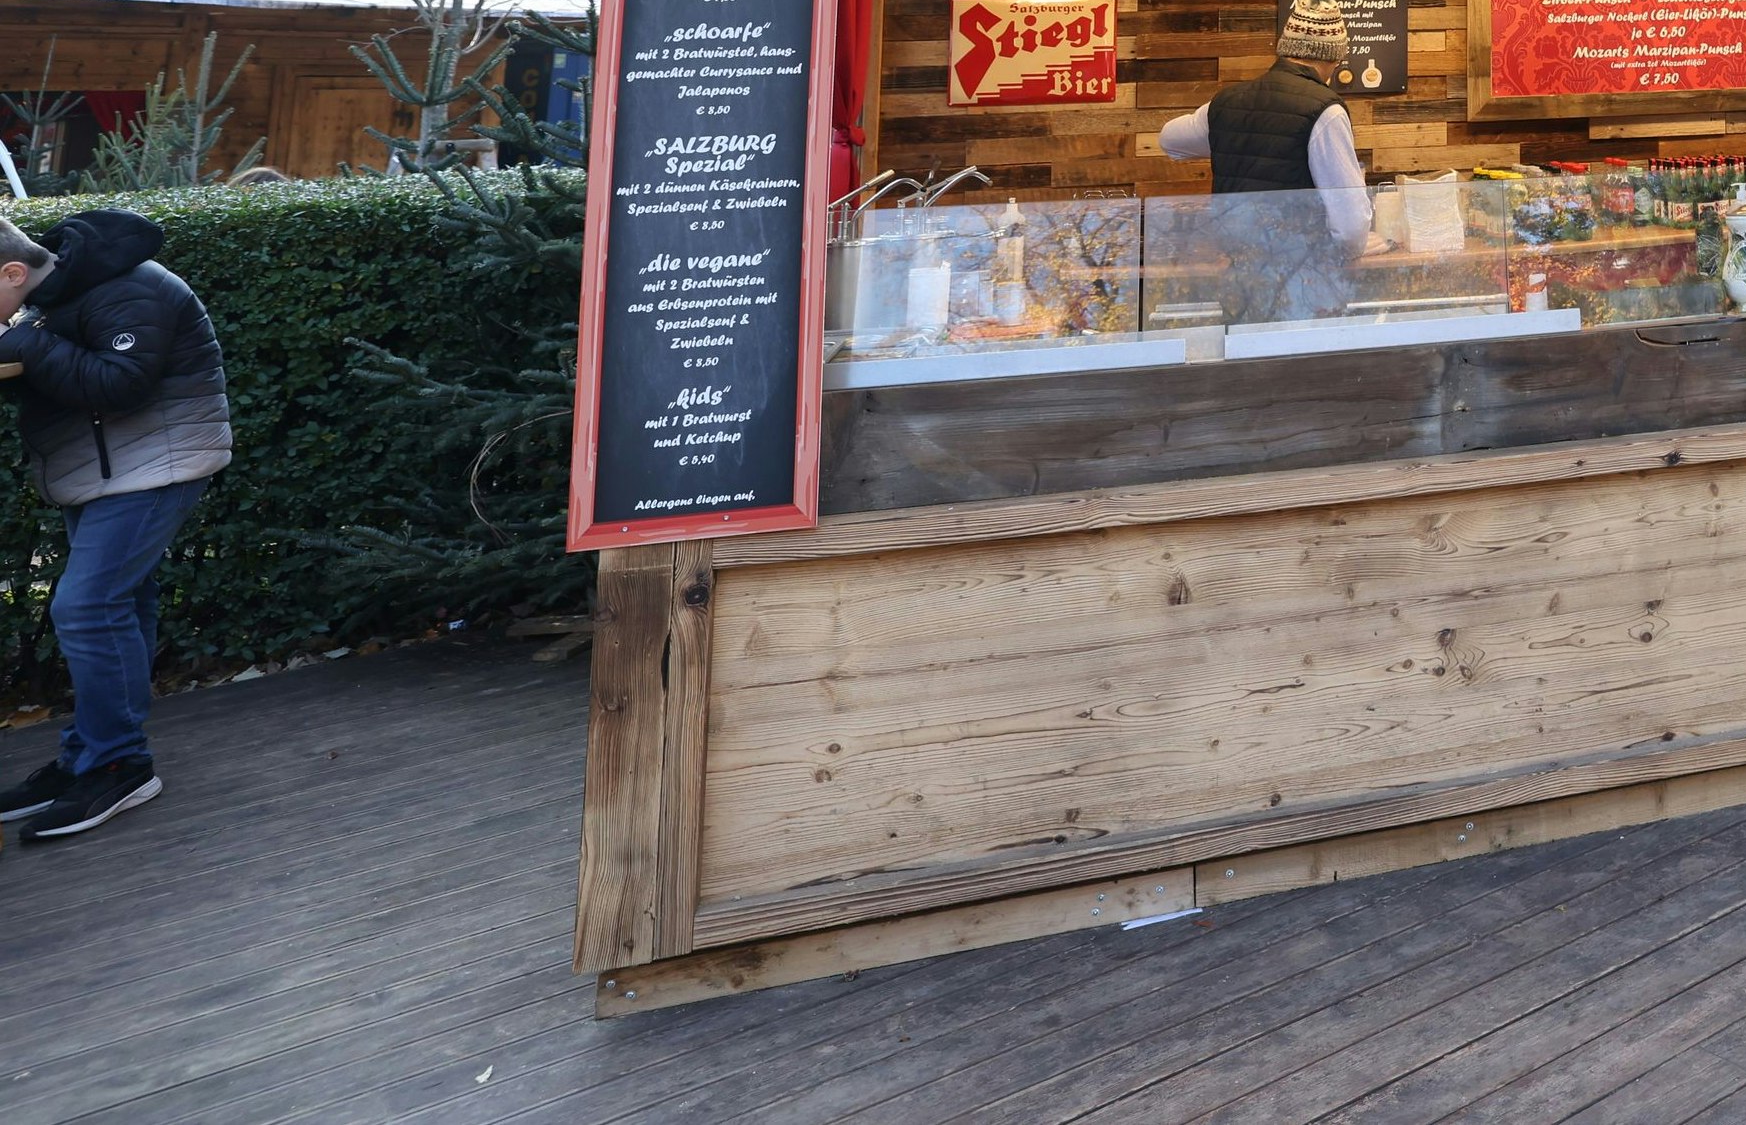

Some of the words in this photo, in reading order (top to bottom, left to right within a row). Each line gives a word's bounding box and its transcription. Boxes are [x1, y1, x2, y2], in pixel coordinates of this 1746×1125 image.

[1009, 3, 1084, 15] Salzburger
[1347, 21, 1382, 29] Marzipan
[1547, 13, 1604, 25] Salzburger
[1607, 11, 1648, 23] Nockerl
[1352, 34, 1396, 42] Mozartlikör
[635, 49, 658, 61] mit
[662, 49, 669, 59] 2
[673, 46, 757, 60] Bratwürstel,
[760, 46, 796, 57] haus-
[954, 3, 1110, 101] Stiegl
[1573, 46, 1629, 58] Mozarts
[1633, 42, 1742, 58] Marzipan-Punsch
[626, 67, 696, 82] gemachter
[699, 66, 773, 78] Currysauce
[777, 63, 802, 74] und
[1640, 73, 1649, 85] €
[1654, 73, 1679, 85] 7,50
[1047, 69, 1112, 96] Bier
[678, 85, 750, 99] Jalapenos
[616, 184, 640, 196] mit
[643, 183, 651, 194] 2
[655, 181, 705, 194] dünnen
[709, 177, 800, 191] Käsekrainern,
[628, 303, 654, 313] aus
[658, 295, 751, 310] Erbsenprotein
[755, 292, 777, 305] mit
[654, 434, 681, 448] und
[685, 431, 741, 445] Ketchup
[635, 498, 693, 510] Allergene
[696, 493, 731, 506] liegen
